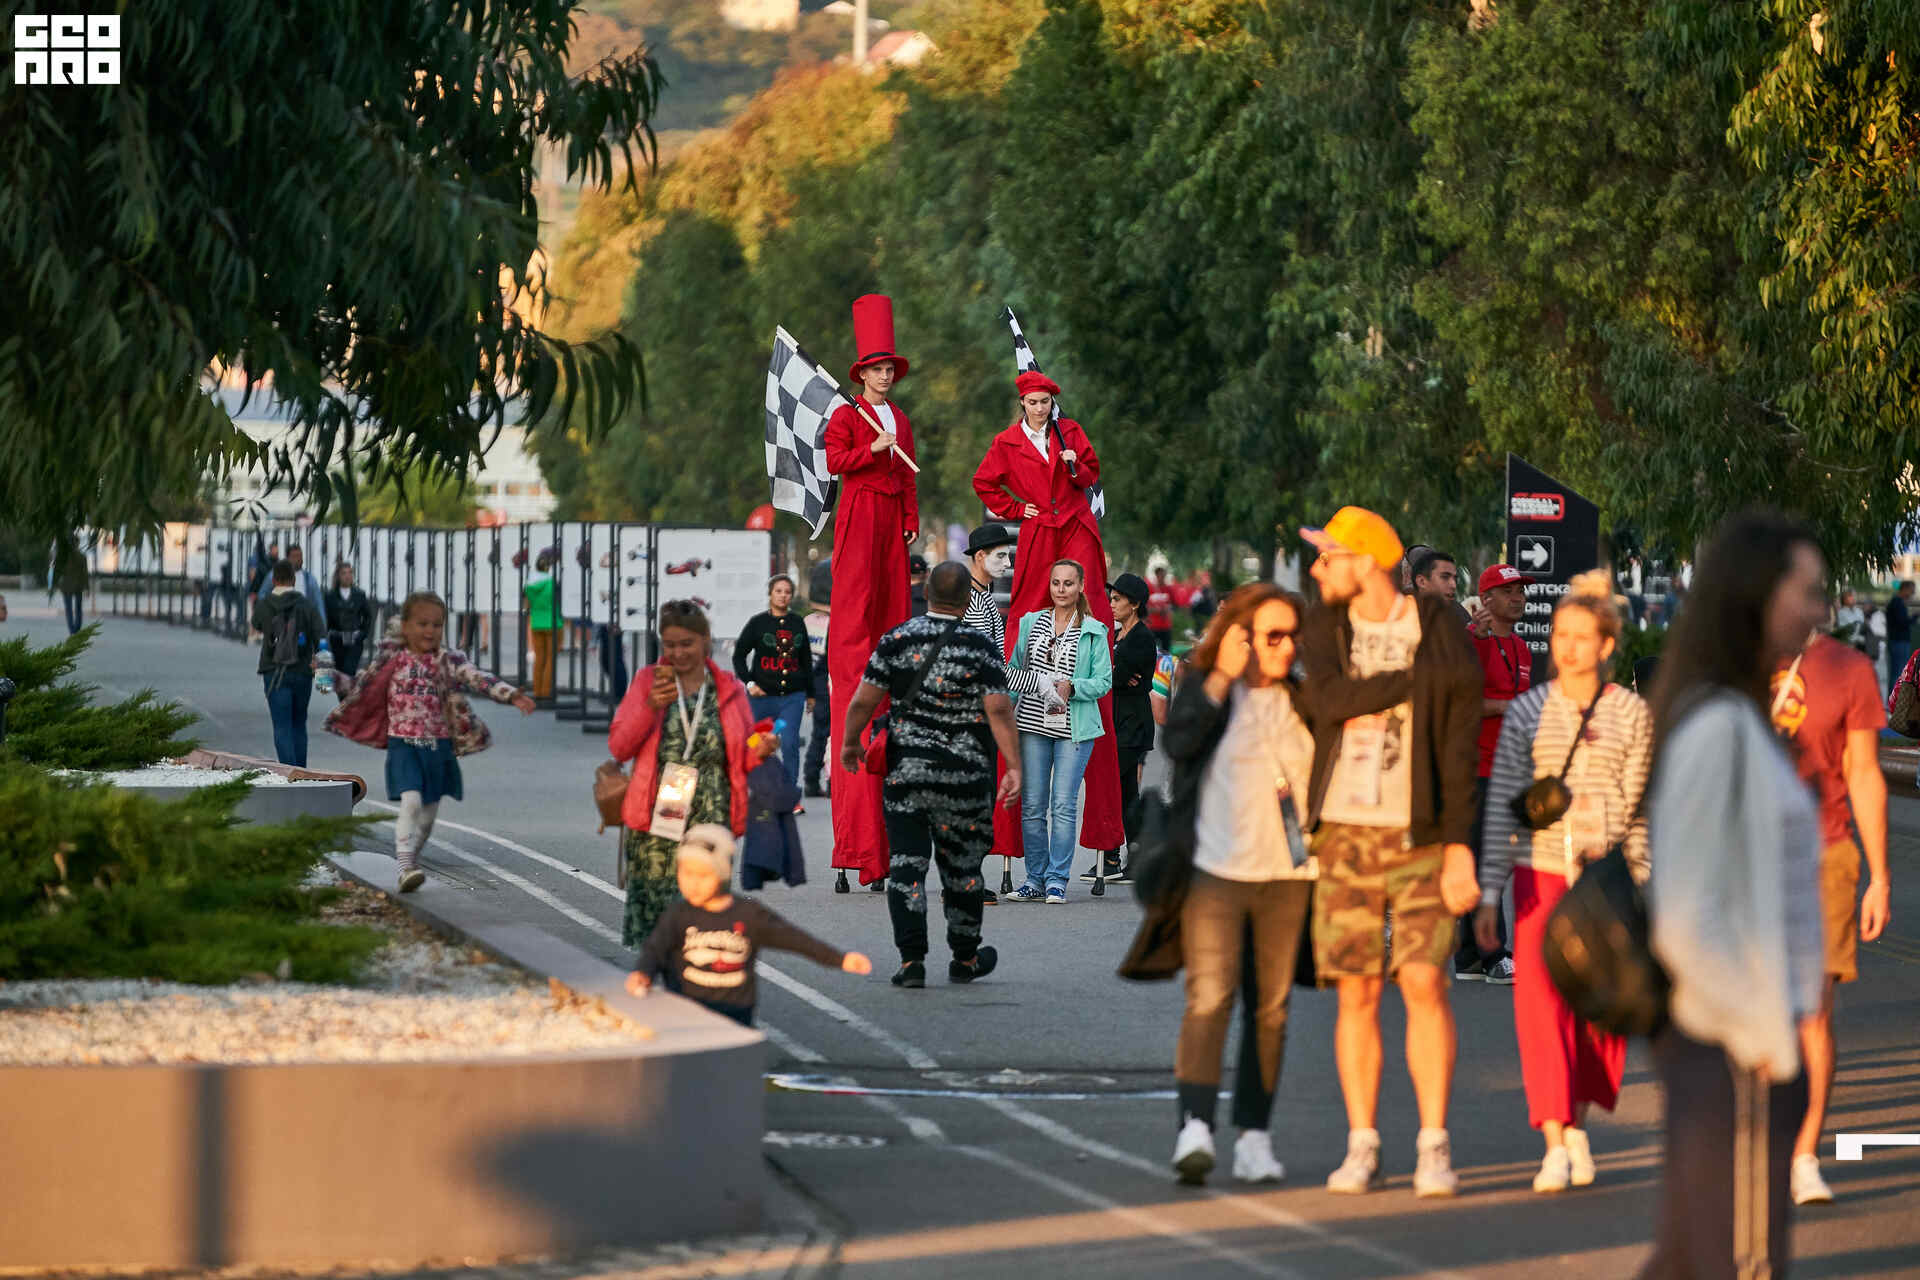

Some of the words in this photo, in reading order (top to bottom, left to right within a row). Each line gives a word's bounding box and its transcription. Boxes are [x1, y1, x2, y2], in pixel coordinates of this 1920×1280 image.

[1524, 583, 1571, 597] етска
[1525, 602, 1552, 614] она
[1526, 641, 1548, 652] rea
